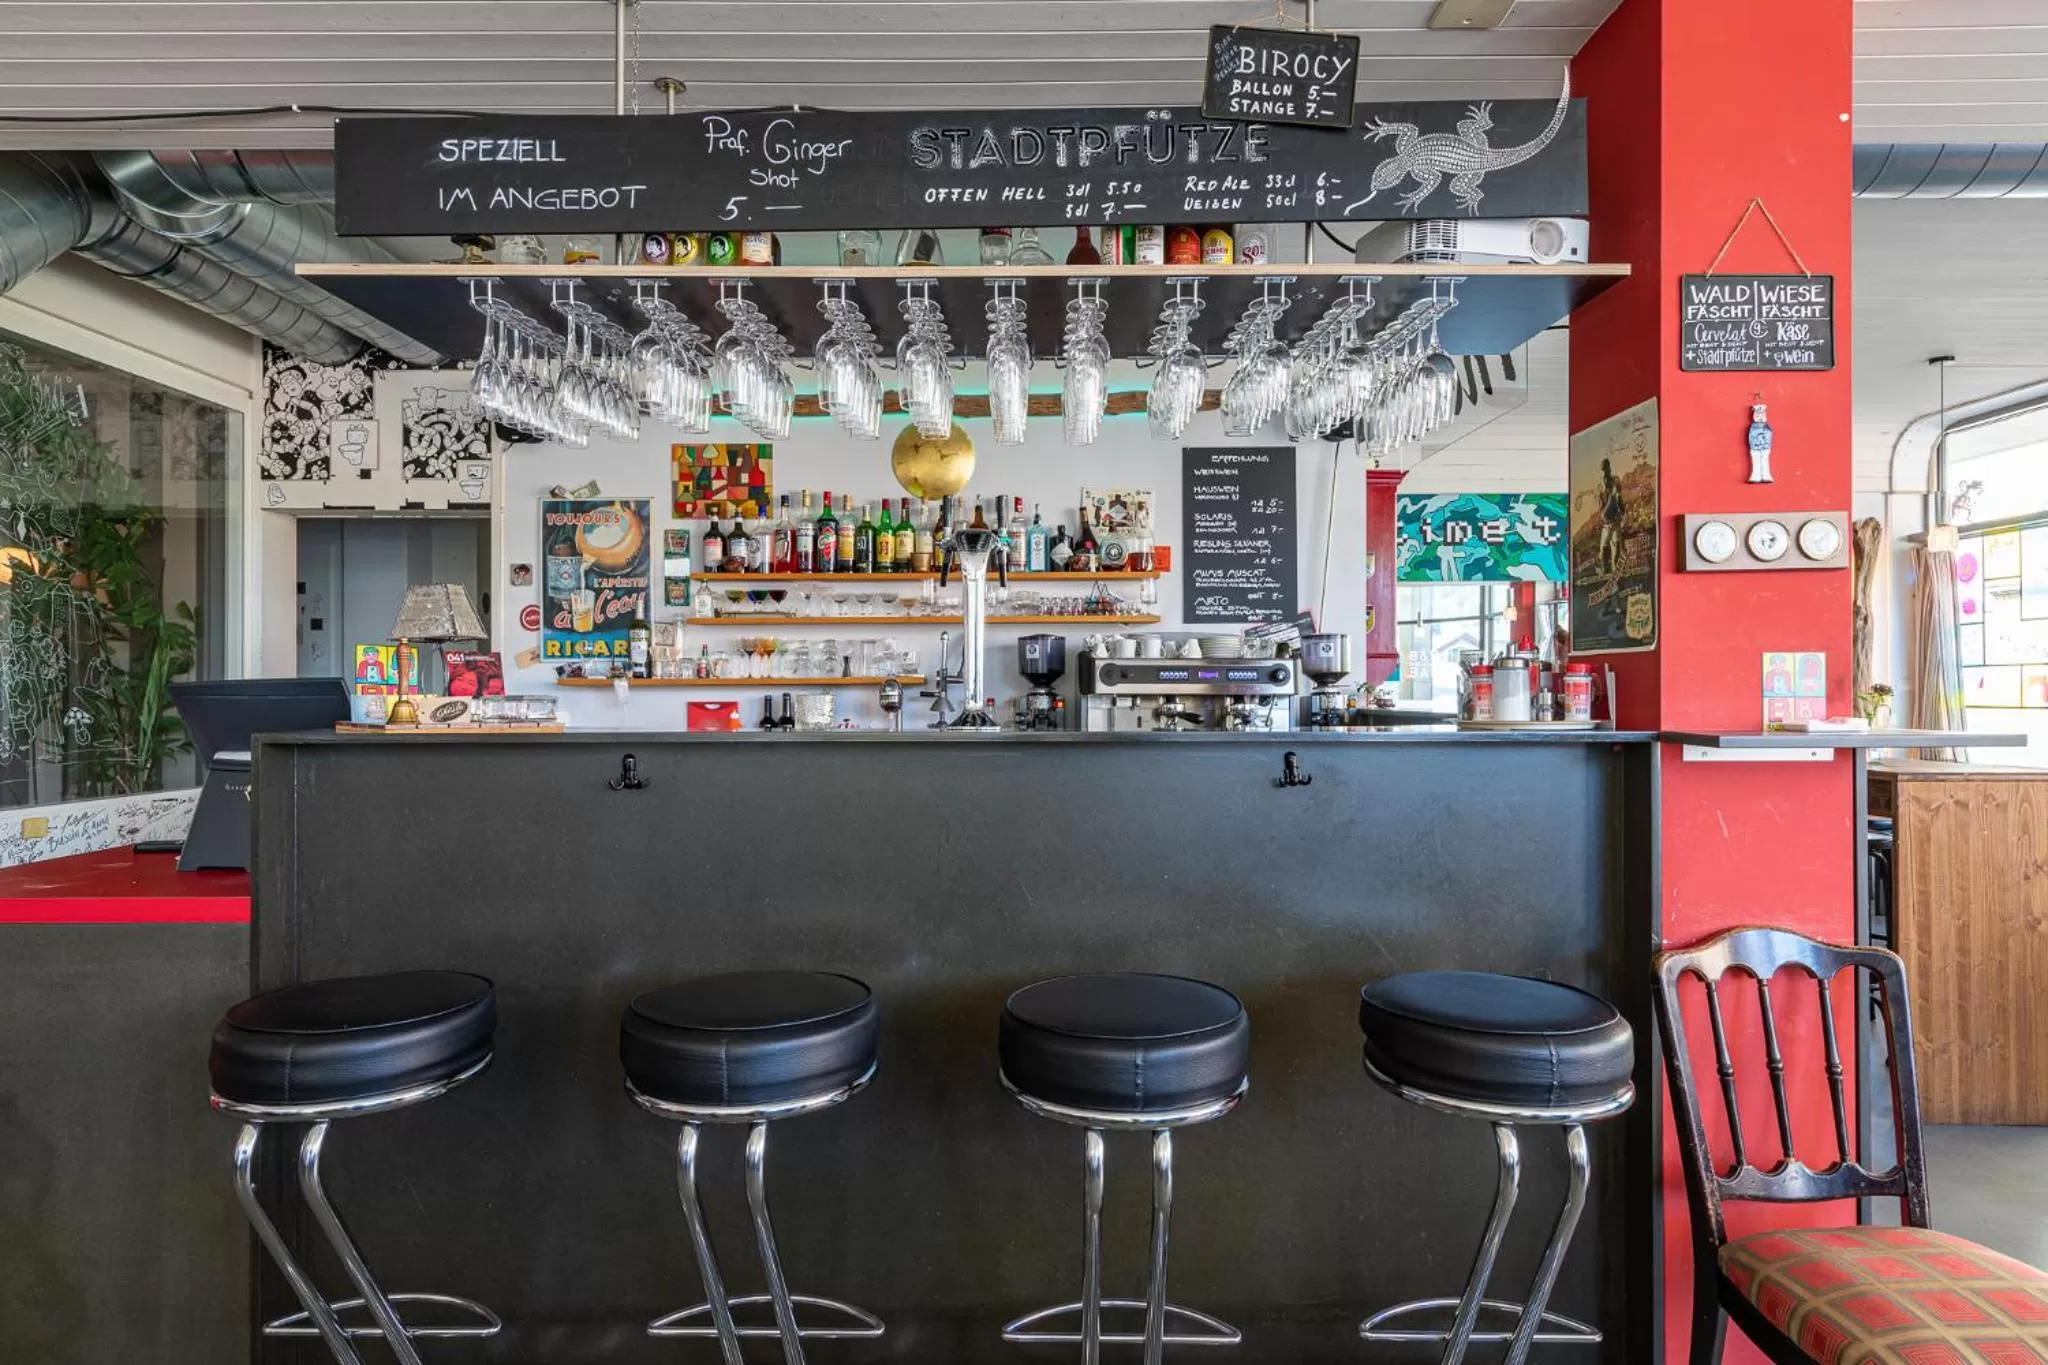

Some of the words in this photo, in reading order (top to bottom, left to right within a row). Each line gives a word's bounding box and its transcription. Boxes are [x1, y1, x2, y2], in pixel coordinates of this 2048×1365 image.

[1235, 46, 1351, 85] BIROCY
[1229, 79, 1293, 96] BALLON
[1229, 98, 1296, 116] STANGE
[702, 115, 750, 157] Prof.
[763, 119, 853, 175] Ginger
[910, 110, 1271, 169] STADTPFÜTZE
[438, 138, 567, 163] SPEZIELL
[924, 187, 988, 203] OFFEN
[1002, 187, 1047, 201] HELL
[1065, 182, 1091, 198] 3dl
[1106, 181, 1143, 196] 5.50
[1185, 175, 1218, 192] RED
[1221, 175, 1251, 191] ALE
[439, 187, 478, 211] IM
[488, 185, 648, 210] ANGEBOT
[1690, 284, 1750, 304] WALD
[1687, 304, 1753, 320] FÄSCHT
[1762, 304, 1825, 319] FÄSCHT
[1776, 321, 1810, 342] Käse
[1696, 347, 1756, 367] Stadtpfütze
[546, 512, 620, 526] TOUJOURS
[1193, 513, 1233, 521] SOLARIS
[1227, 568, 1267, 578] MUSCAT
[546, 639, 629, 656] RICAR
